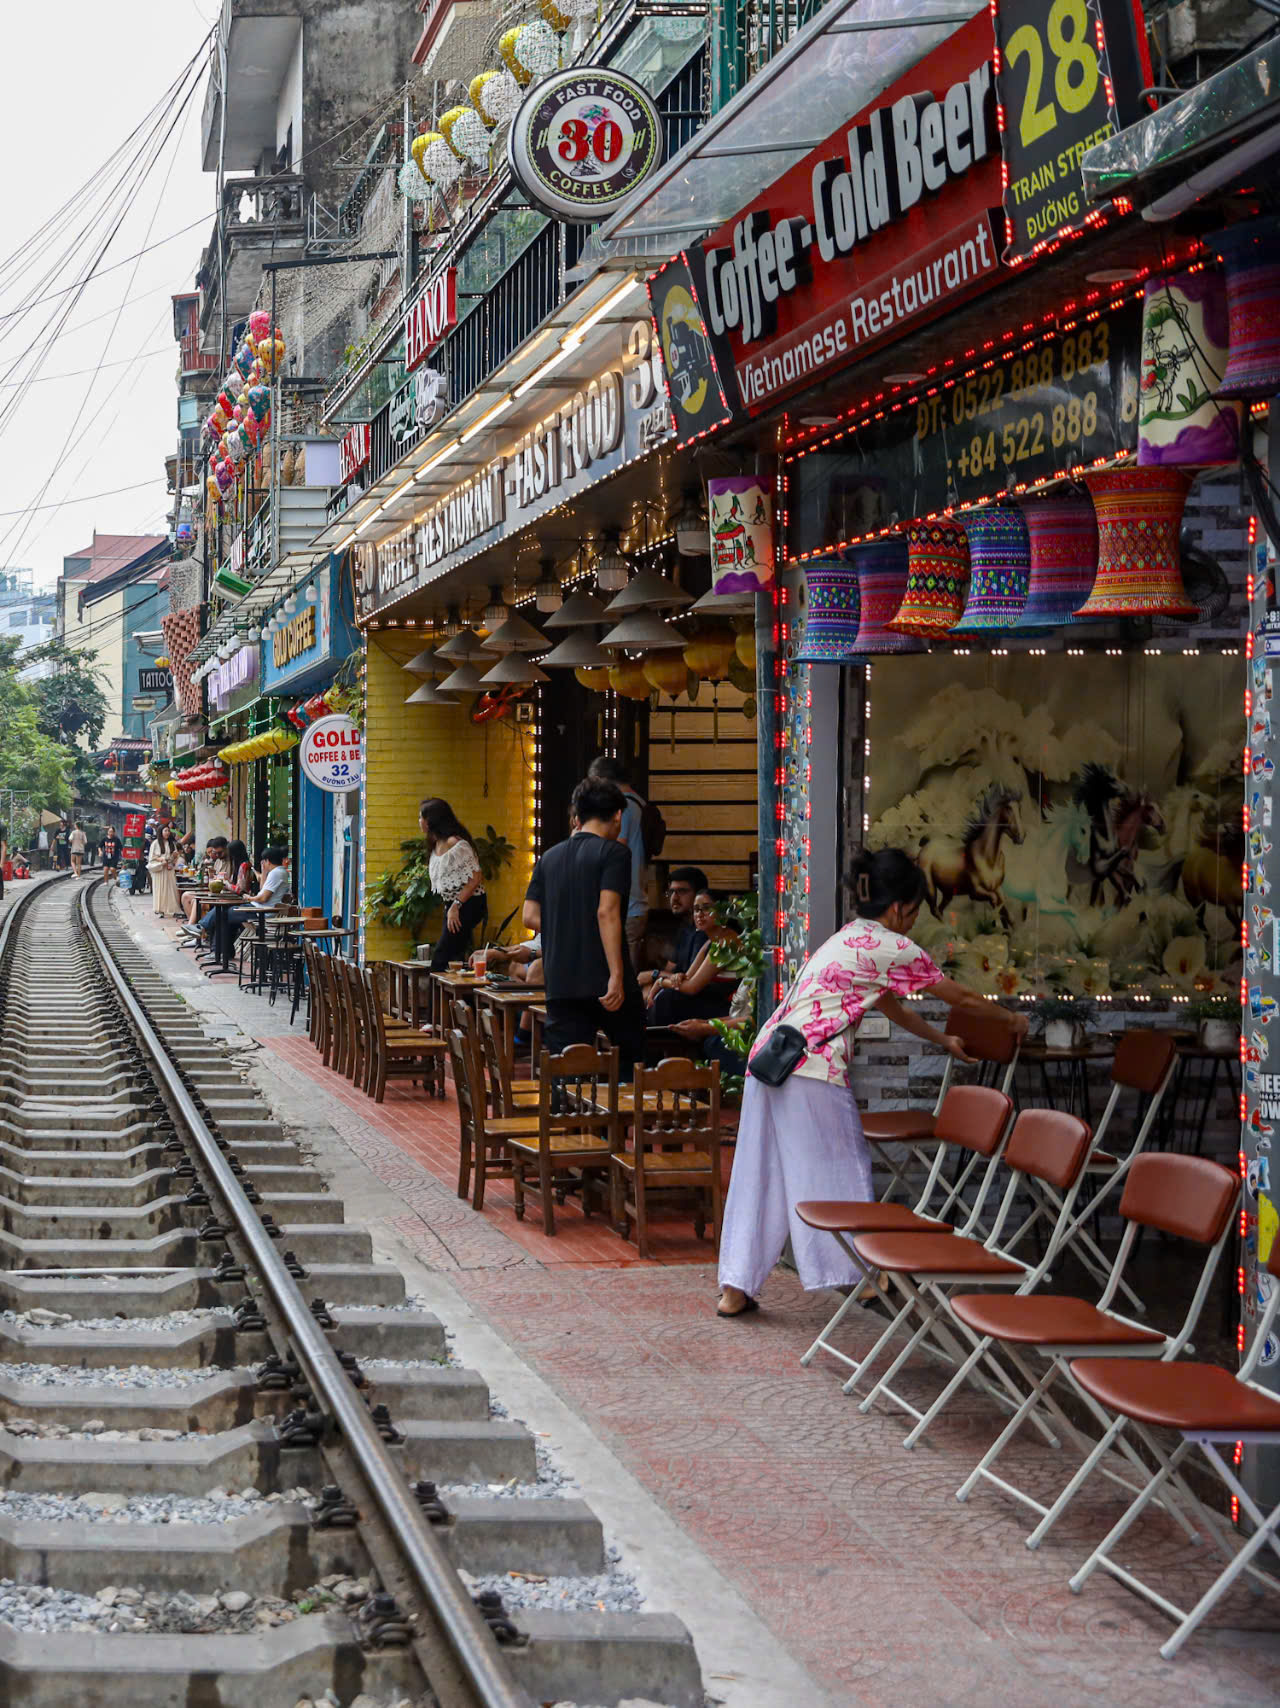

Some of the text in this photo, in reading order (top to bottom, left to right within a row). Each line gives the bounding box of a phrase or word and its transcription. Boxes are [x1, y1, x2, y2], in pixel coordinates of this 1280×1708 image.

[555, 82, 642, 121] FAST FOOD
[1004, 0, 1098, 148] 28
[549, 170, 613, 196] COFFEE
[558, 119, 623, 164] 30
[1011, 160, 1056, 206] TRAIN
[1057, 122, 1114, 178] STREET
[705, 212, 797, 345] Coffee
[812, 108, 890, 262] Cold
[892, 60, 990, 212] Beer
[1026, 191, 1079, 240] ĐƯỜNG
[404, 270, 450, 372] HANOI
[736, 223, 992, 405] Vietnamese Restaurant
[952, 369, 1005, 425] 0522
[1011, 347, 1054, 401] 888
[1062, 321, 1110, 382] 883
[422, 457, 505, 569] RESTAURANT
[515, 412, 560, 508] FAST
[560, 371, 623, 479] FOOD
[958, 431, 997, 477] +84
[1002, 412, 1045, 465] 522
[1051, 391, 1098, 449] 888
[308, 751, 339, 763] COFFEE
[341, 750, 347, 761] &
[313, 729, 360, 748] GOLD
[331, 764, 349, 777] 32
